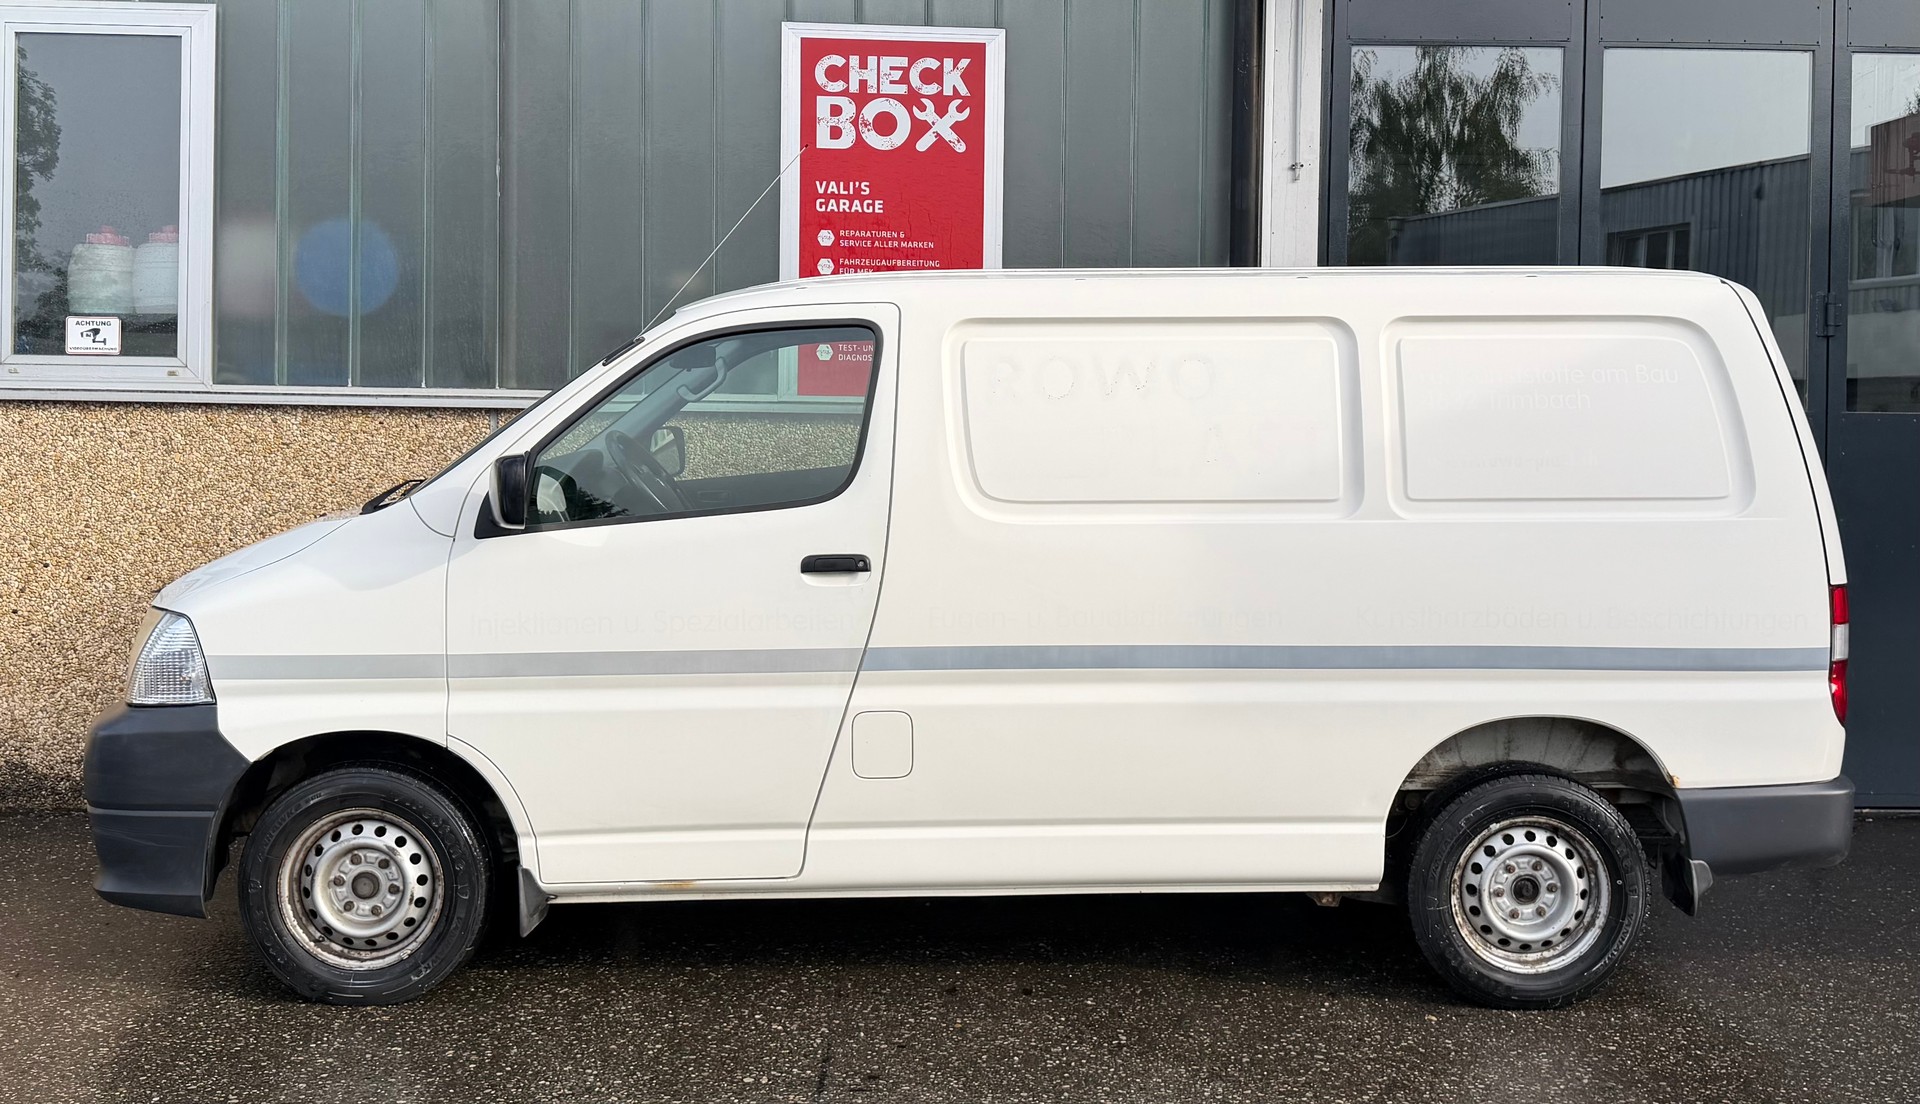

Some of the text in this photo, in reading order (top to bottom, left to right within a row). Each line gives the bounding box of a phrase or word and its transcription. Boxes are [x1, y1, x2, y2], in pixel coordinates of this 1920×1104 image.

[814, 54, 971, 96] CHECK
[815, 180, 870, 195] VALI'S
[815, 198, 884, 213] GARAGE
[839, 230, 898, 238] REPARATUREN
[839, 239, 934, 249] SERVICE ALLER MARKEN
[839, 258, 940, 267] FAHRZEUGAUFBEREITUNG
[1592, 368, 1629, 384] am
[1634, 363, 1680, 385] Bau
[1487, 389, 1592, 411] Trimbach
